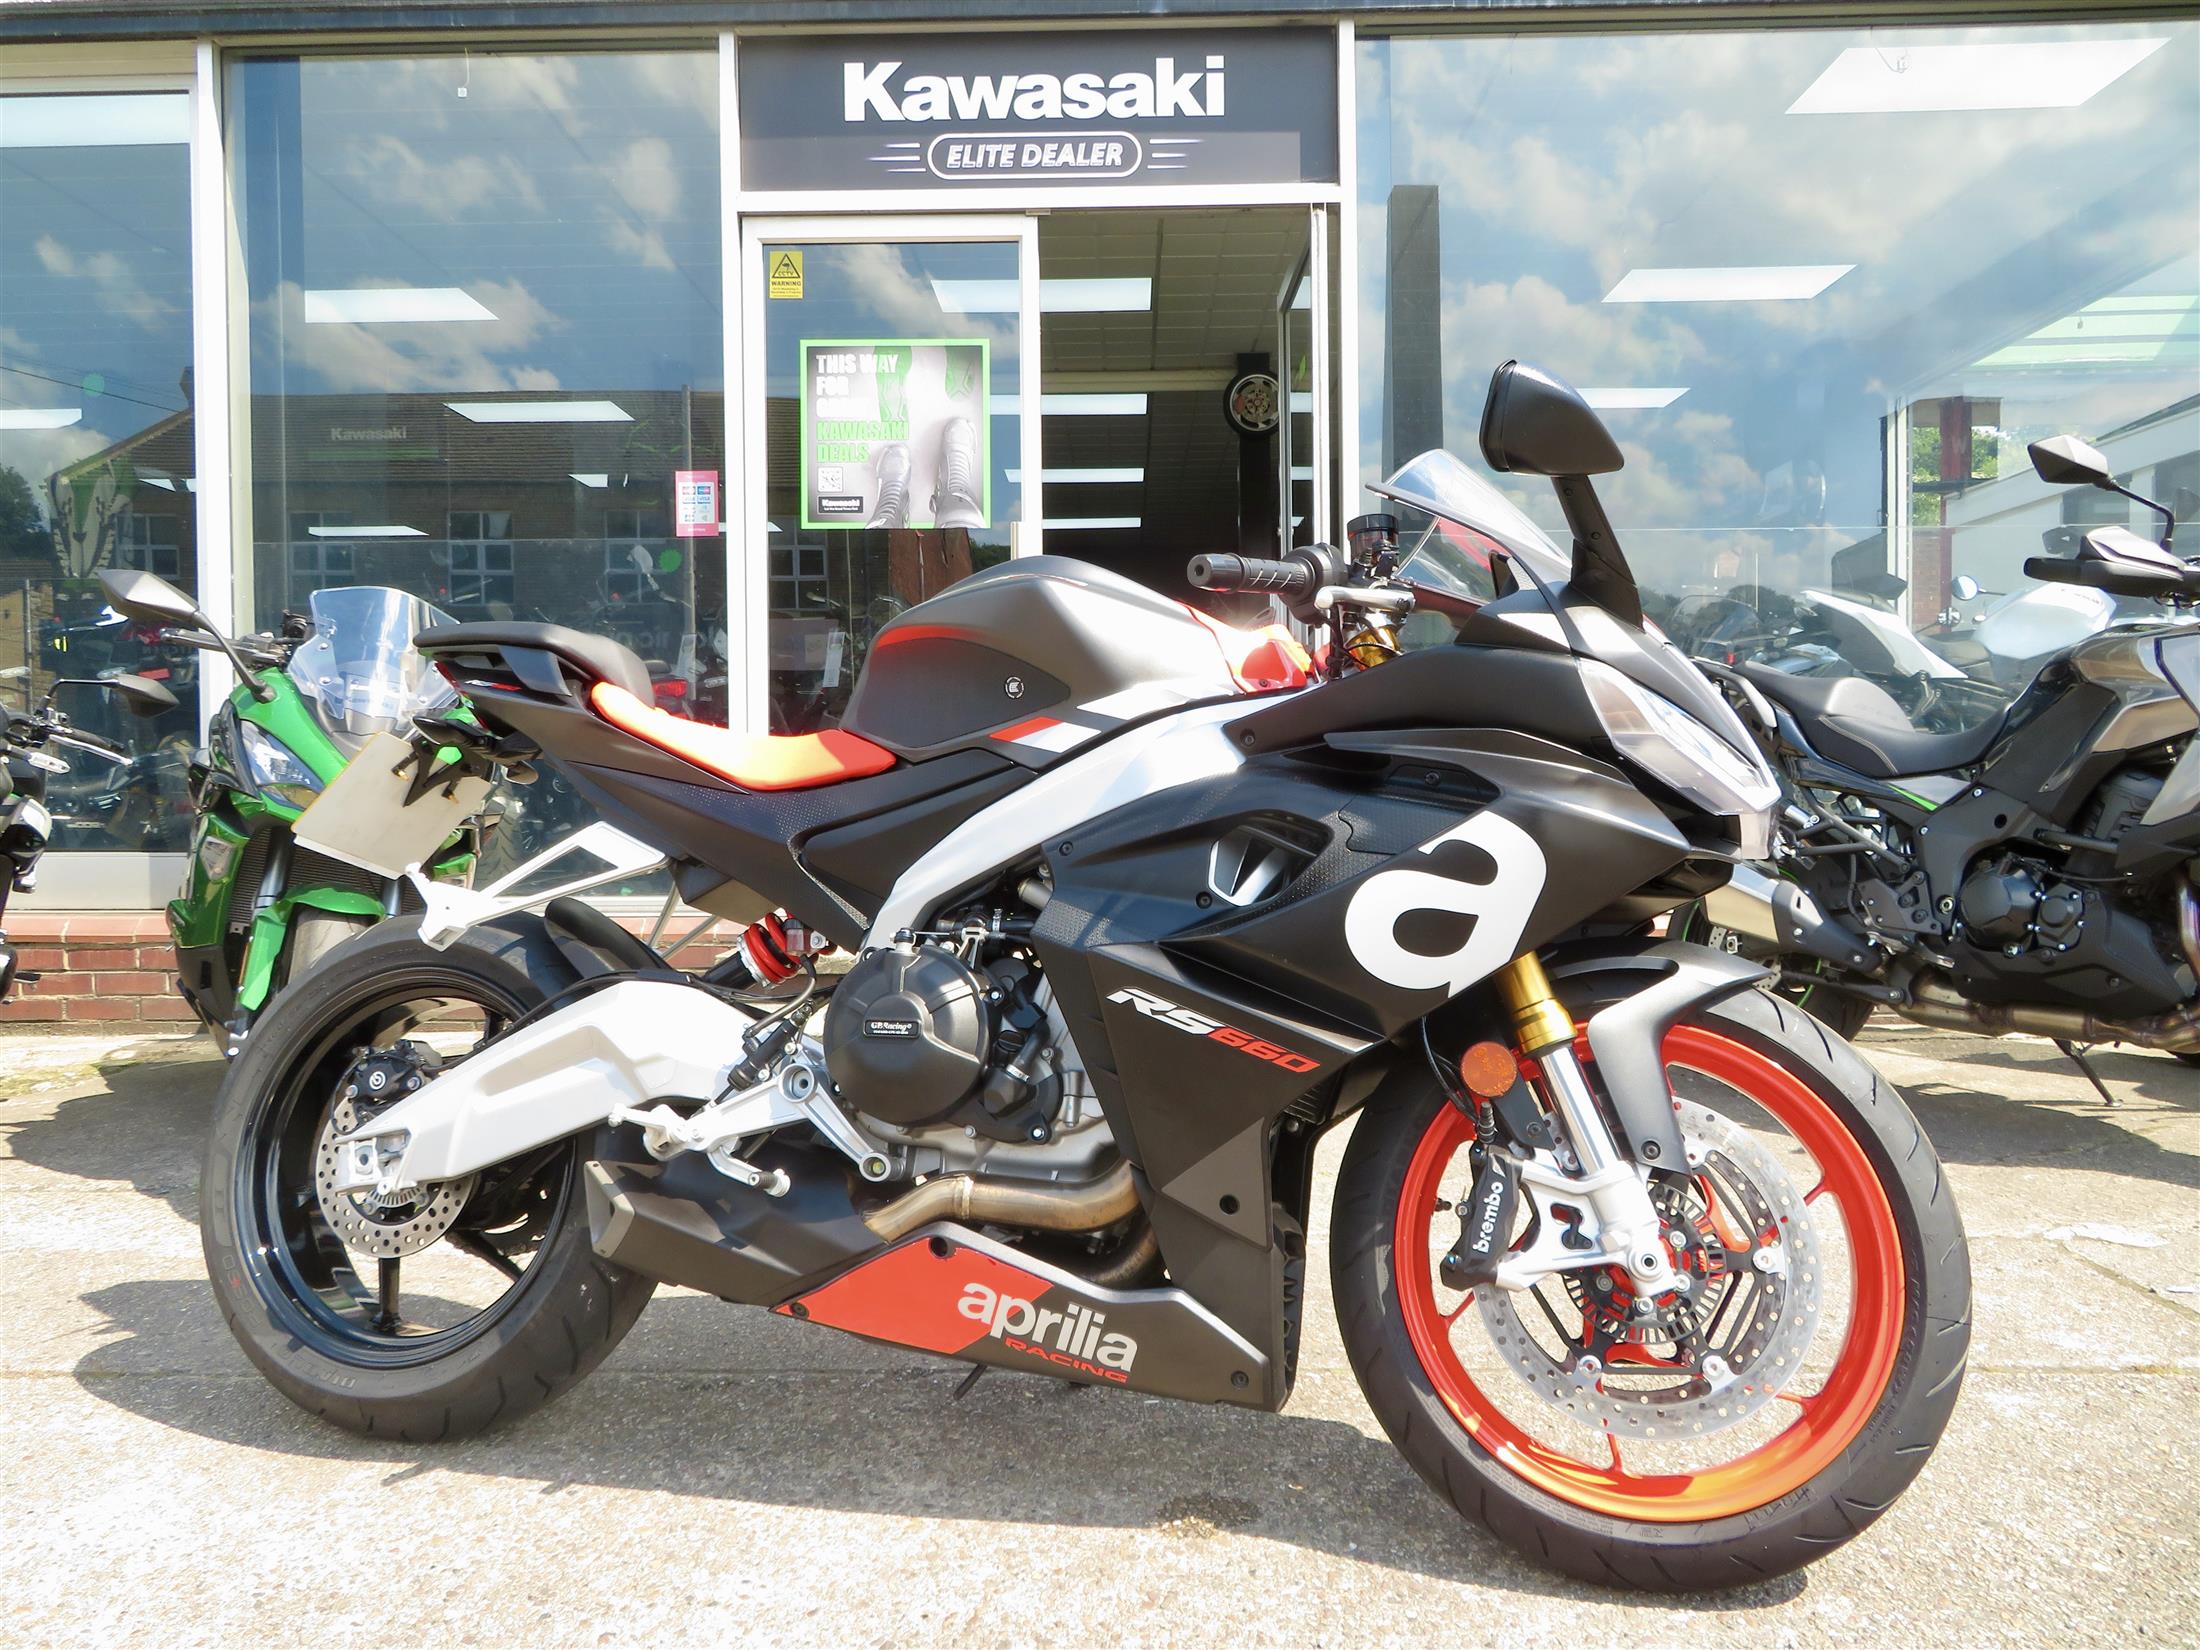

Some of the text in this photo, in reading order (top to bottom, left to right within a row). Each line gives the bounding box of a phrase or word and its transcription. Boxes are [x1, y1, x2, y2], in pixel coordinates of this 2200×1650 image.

[843, 55, 1225, 122] Kawasaki
[946, 141, 1123, 169] ELITE DEALER
[816, 354, 899, 374] THIS WAY
[816, 376, 849, 396] FOR
[330, 426, 407, 441] Kawasaki
[816, 421, 910, 441] KAWASAKI
[816, 443, 870, 463] DEALS
[1473, 1181, 1504, 1254] brembo
[957, 1282, 1138, 1373] aprilia
[1004, 1336, 1129, 1384] RACING
